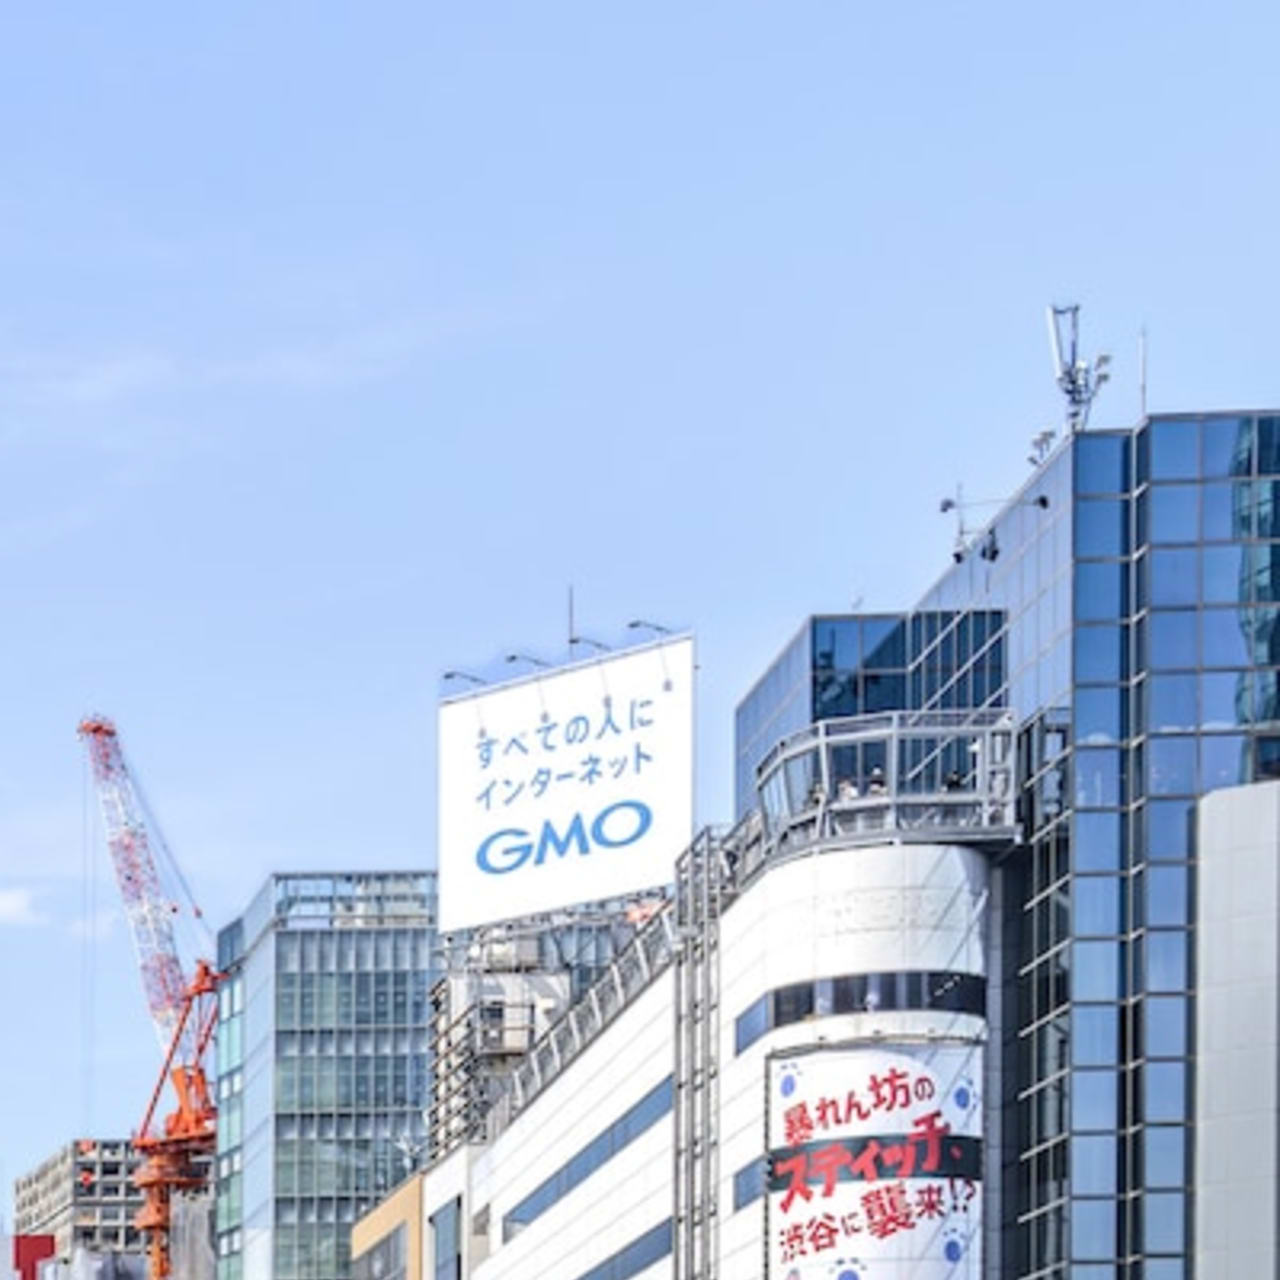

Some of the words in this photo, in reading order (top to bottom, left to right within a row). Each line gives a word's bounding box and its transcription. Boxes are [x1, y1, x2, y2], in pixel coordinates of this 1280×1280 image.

[476, 698, 654, 768] すべての人に
[476, 743, 653, 810] インターネット
[476, 800, 652, 874] GMO
[784, 1067, 936, 1146] 暴れん坊の
